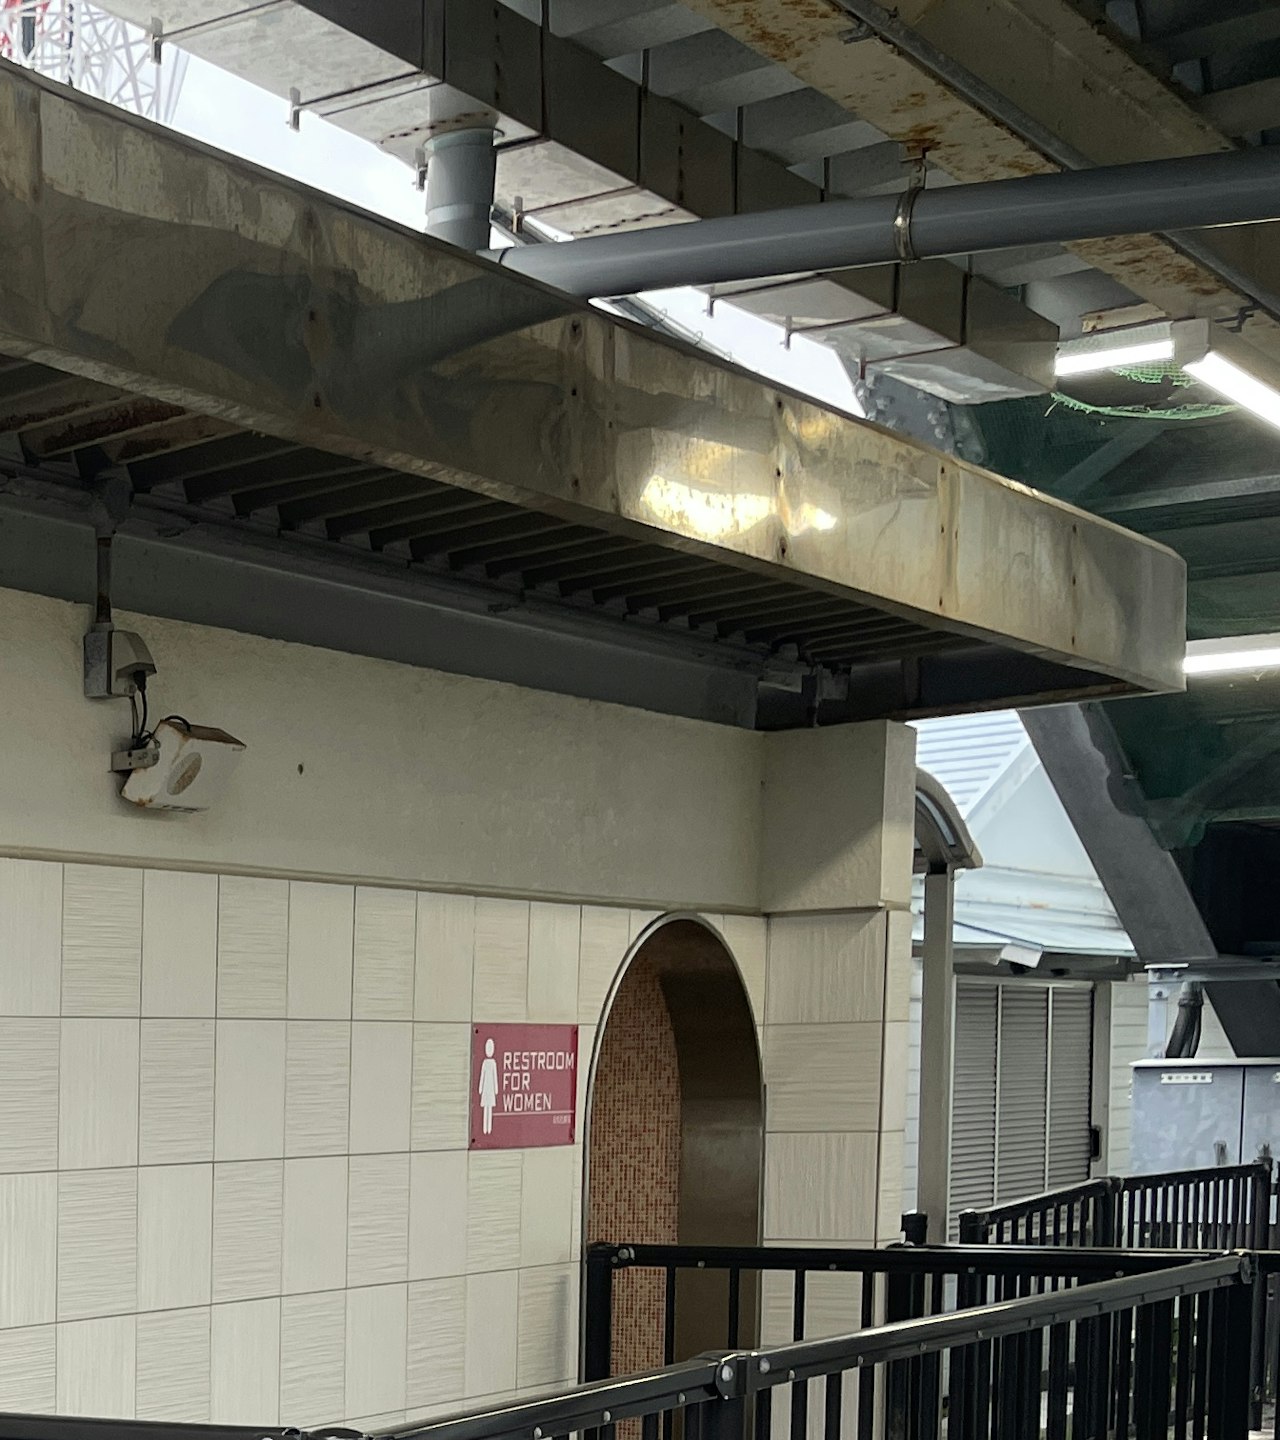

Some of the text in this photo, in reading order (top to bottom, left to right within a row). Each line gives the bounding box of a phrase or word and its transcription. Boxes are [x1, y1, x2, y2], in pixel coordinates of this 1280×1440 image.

[503, 1052, 574, 1070] RESTROOM
[503, 1072, 530, 1091] FOR
[503, 1093, 552, 1112] WOMEN
